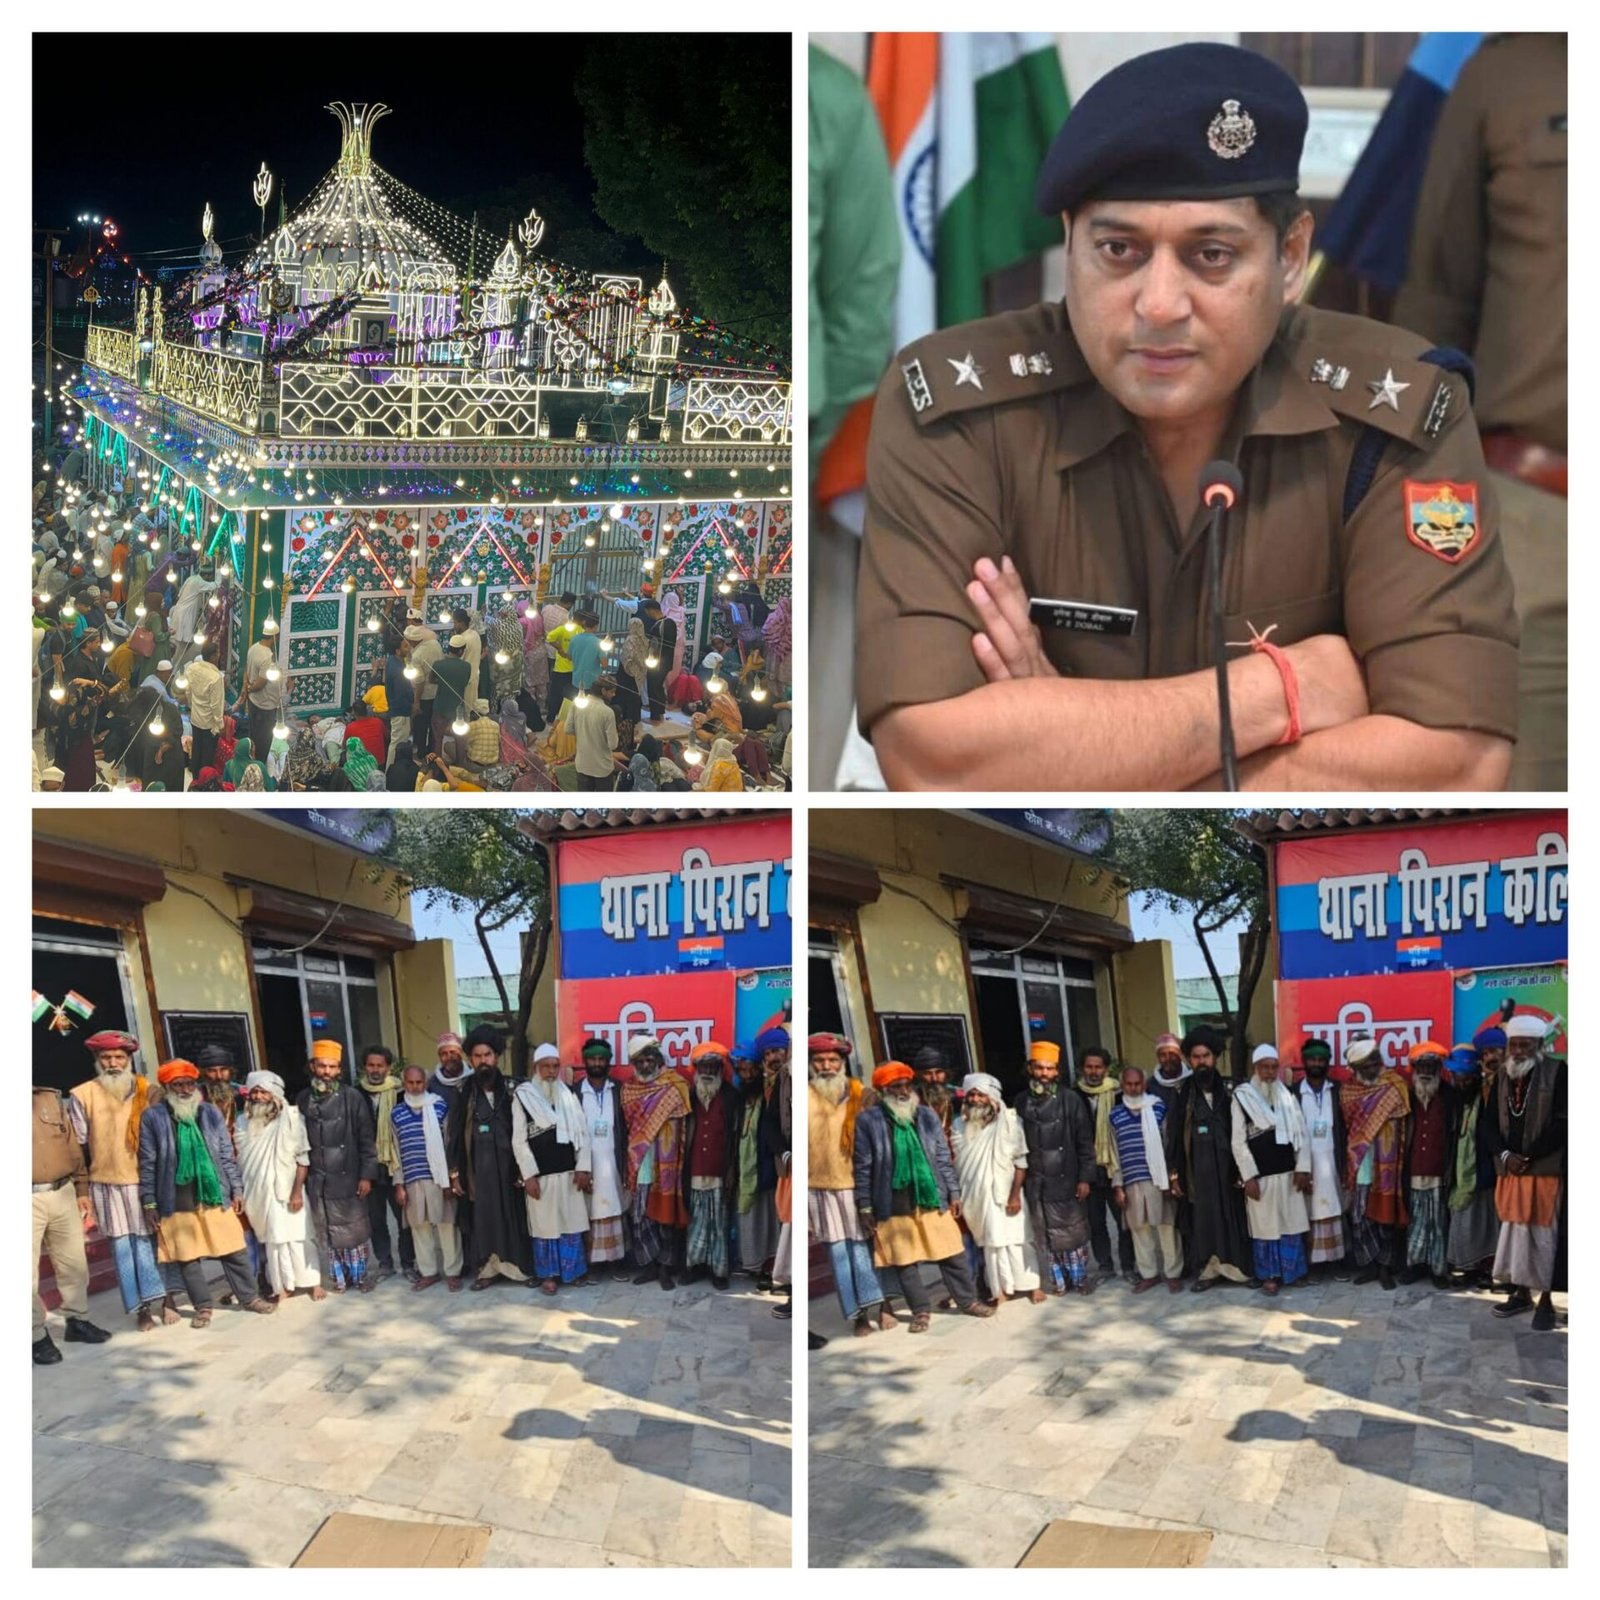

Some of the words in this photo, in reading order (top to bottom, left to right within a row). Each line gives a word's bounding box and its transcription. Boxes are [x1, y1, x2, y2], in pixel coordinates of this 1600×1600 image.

[601, 871, 671, 940] थाना
[680, 847, 774, 934] पिरान
[1318, 872, 1389, 941] थाना
[1398, 848, 1490, 935] पिरान
[584, 1001, 715, 1067] मिला
[1302, 1001, 1433, 1067] मिला
